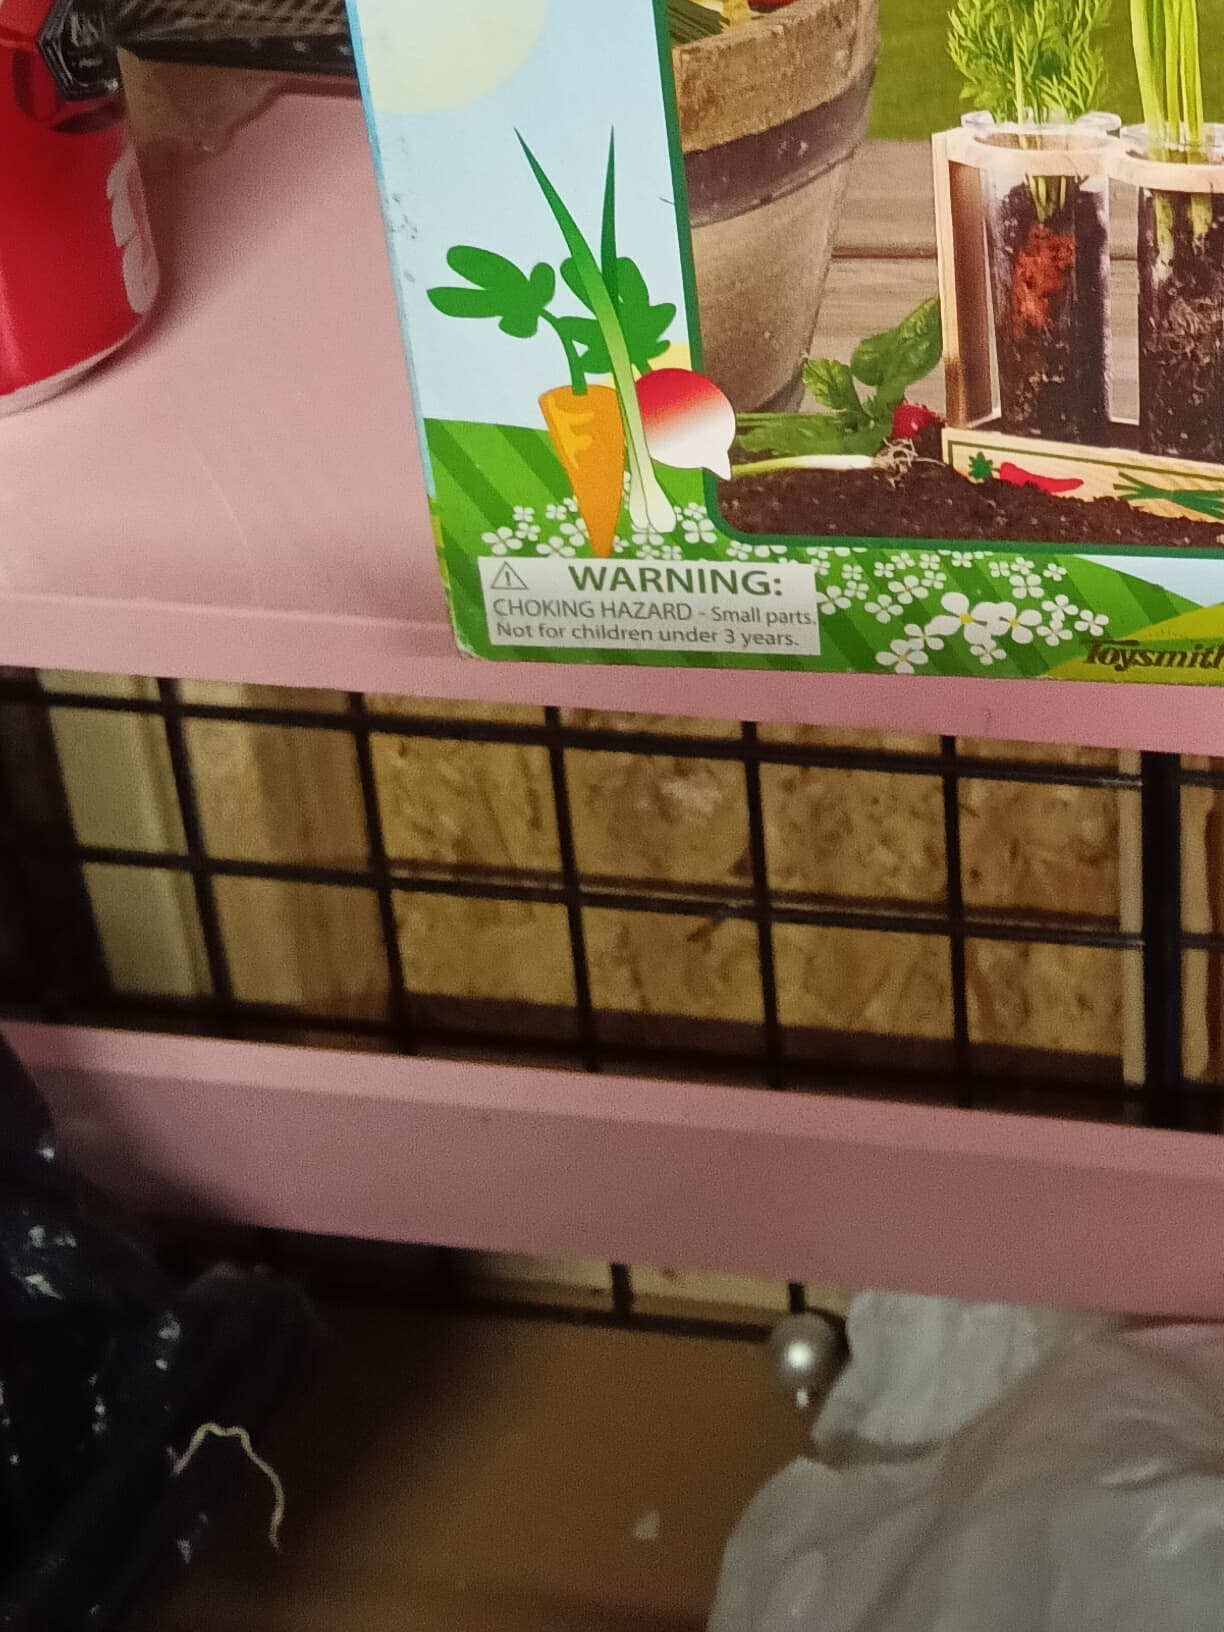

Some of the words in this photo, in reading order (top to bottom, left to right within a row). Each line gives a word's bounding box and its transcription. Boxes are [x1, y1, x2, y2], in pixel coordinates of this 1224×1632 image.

[568, 565, 784, 596] WARNING:
[491, 599, 595, 619] CHOKING
[600, 600, 693, 621] HAZARD
[711, 605, 762, 625] Small
[766, 609, 818, 628] parts.
[497, 622, 535, 639] Not
[538, 622, 567, 639] for
[571, 623, 654, 642] children
[659, 625, 719, 644] under
[723, 628, 736, 644] 3
[741, 630, 800, 648] years.
